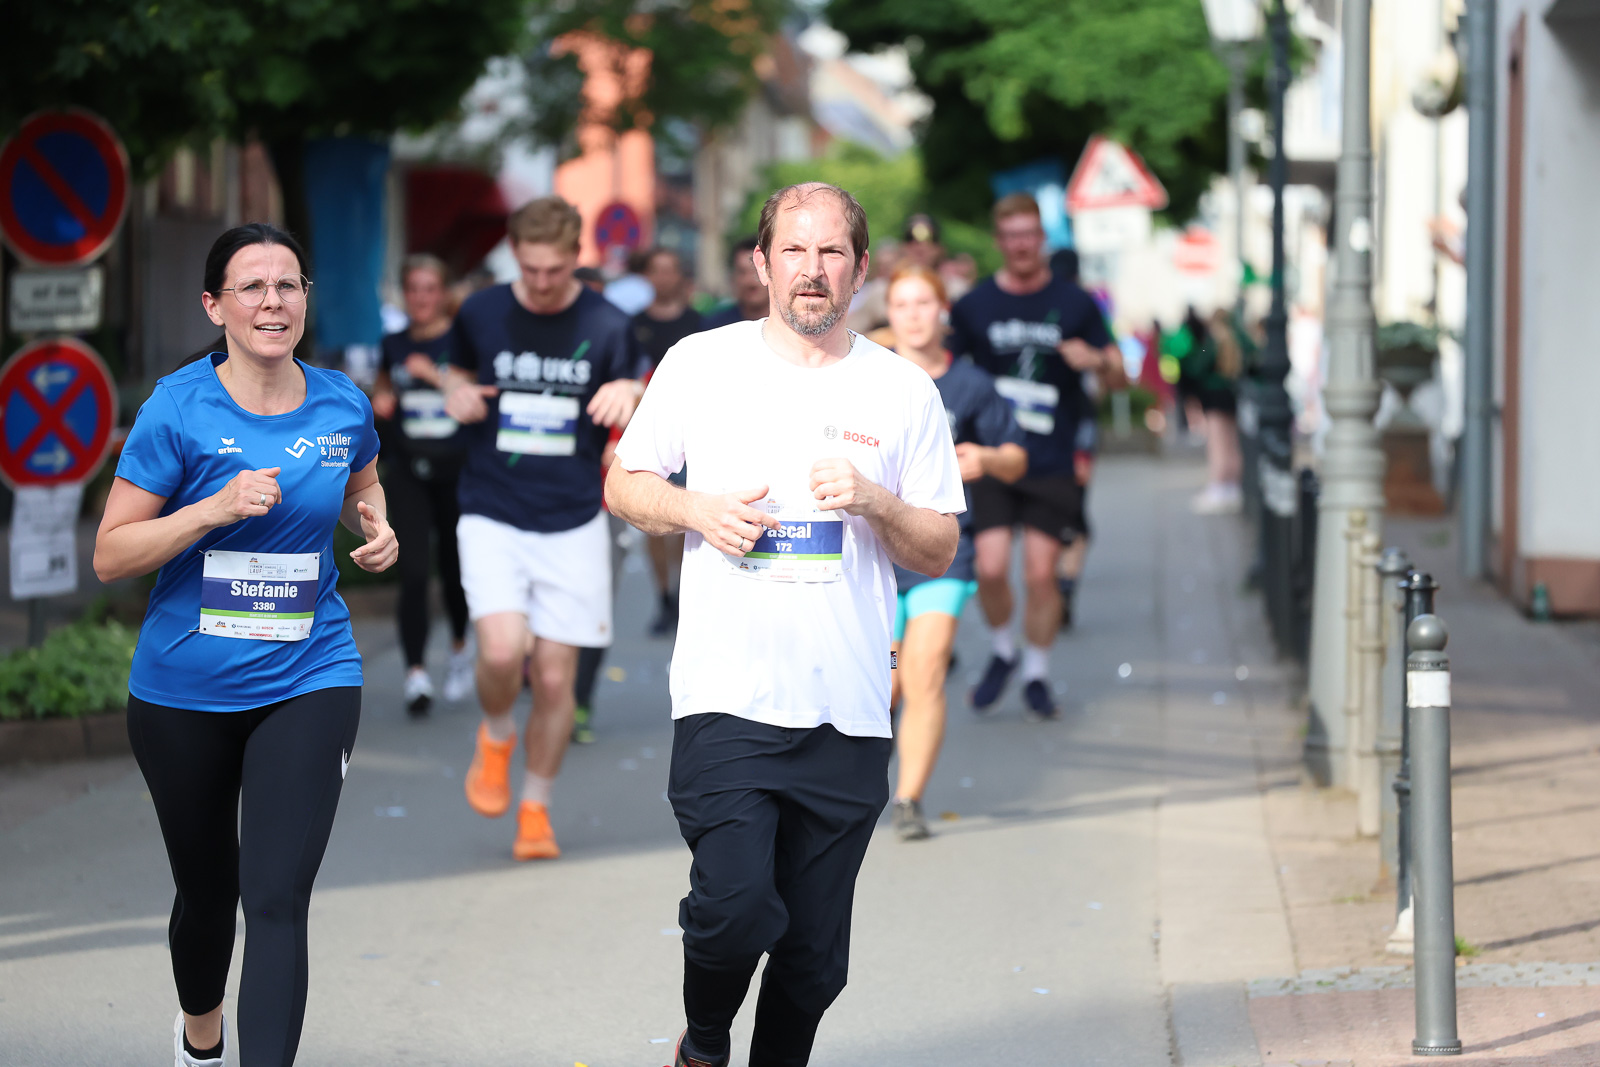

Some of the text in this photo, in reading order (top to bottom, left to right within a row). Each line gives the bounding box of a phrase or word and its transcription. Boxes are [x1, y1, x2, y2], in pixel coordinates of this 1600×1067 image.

[316, 433, 352, 446] müller
[843, 430, 880, 448] BOSCH
[217, 446, 243, 455] erima
[320, 444, 349, 460] & jung
[762, 523, 812, 539] ascal
[775, 542, 793, 552] 172
[230, 580, 298, 598] Stefanie
[252, 601, 276, 611] 3380
